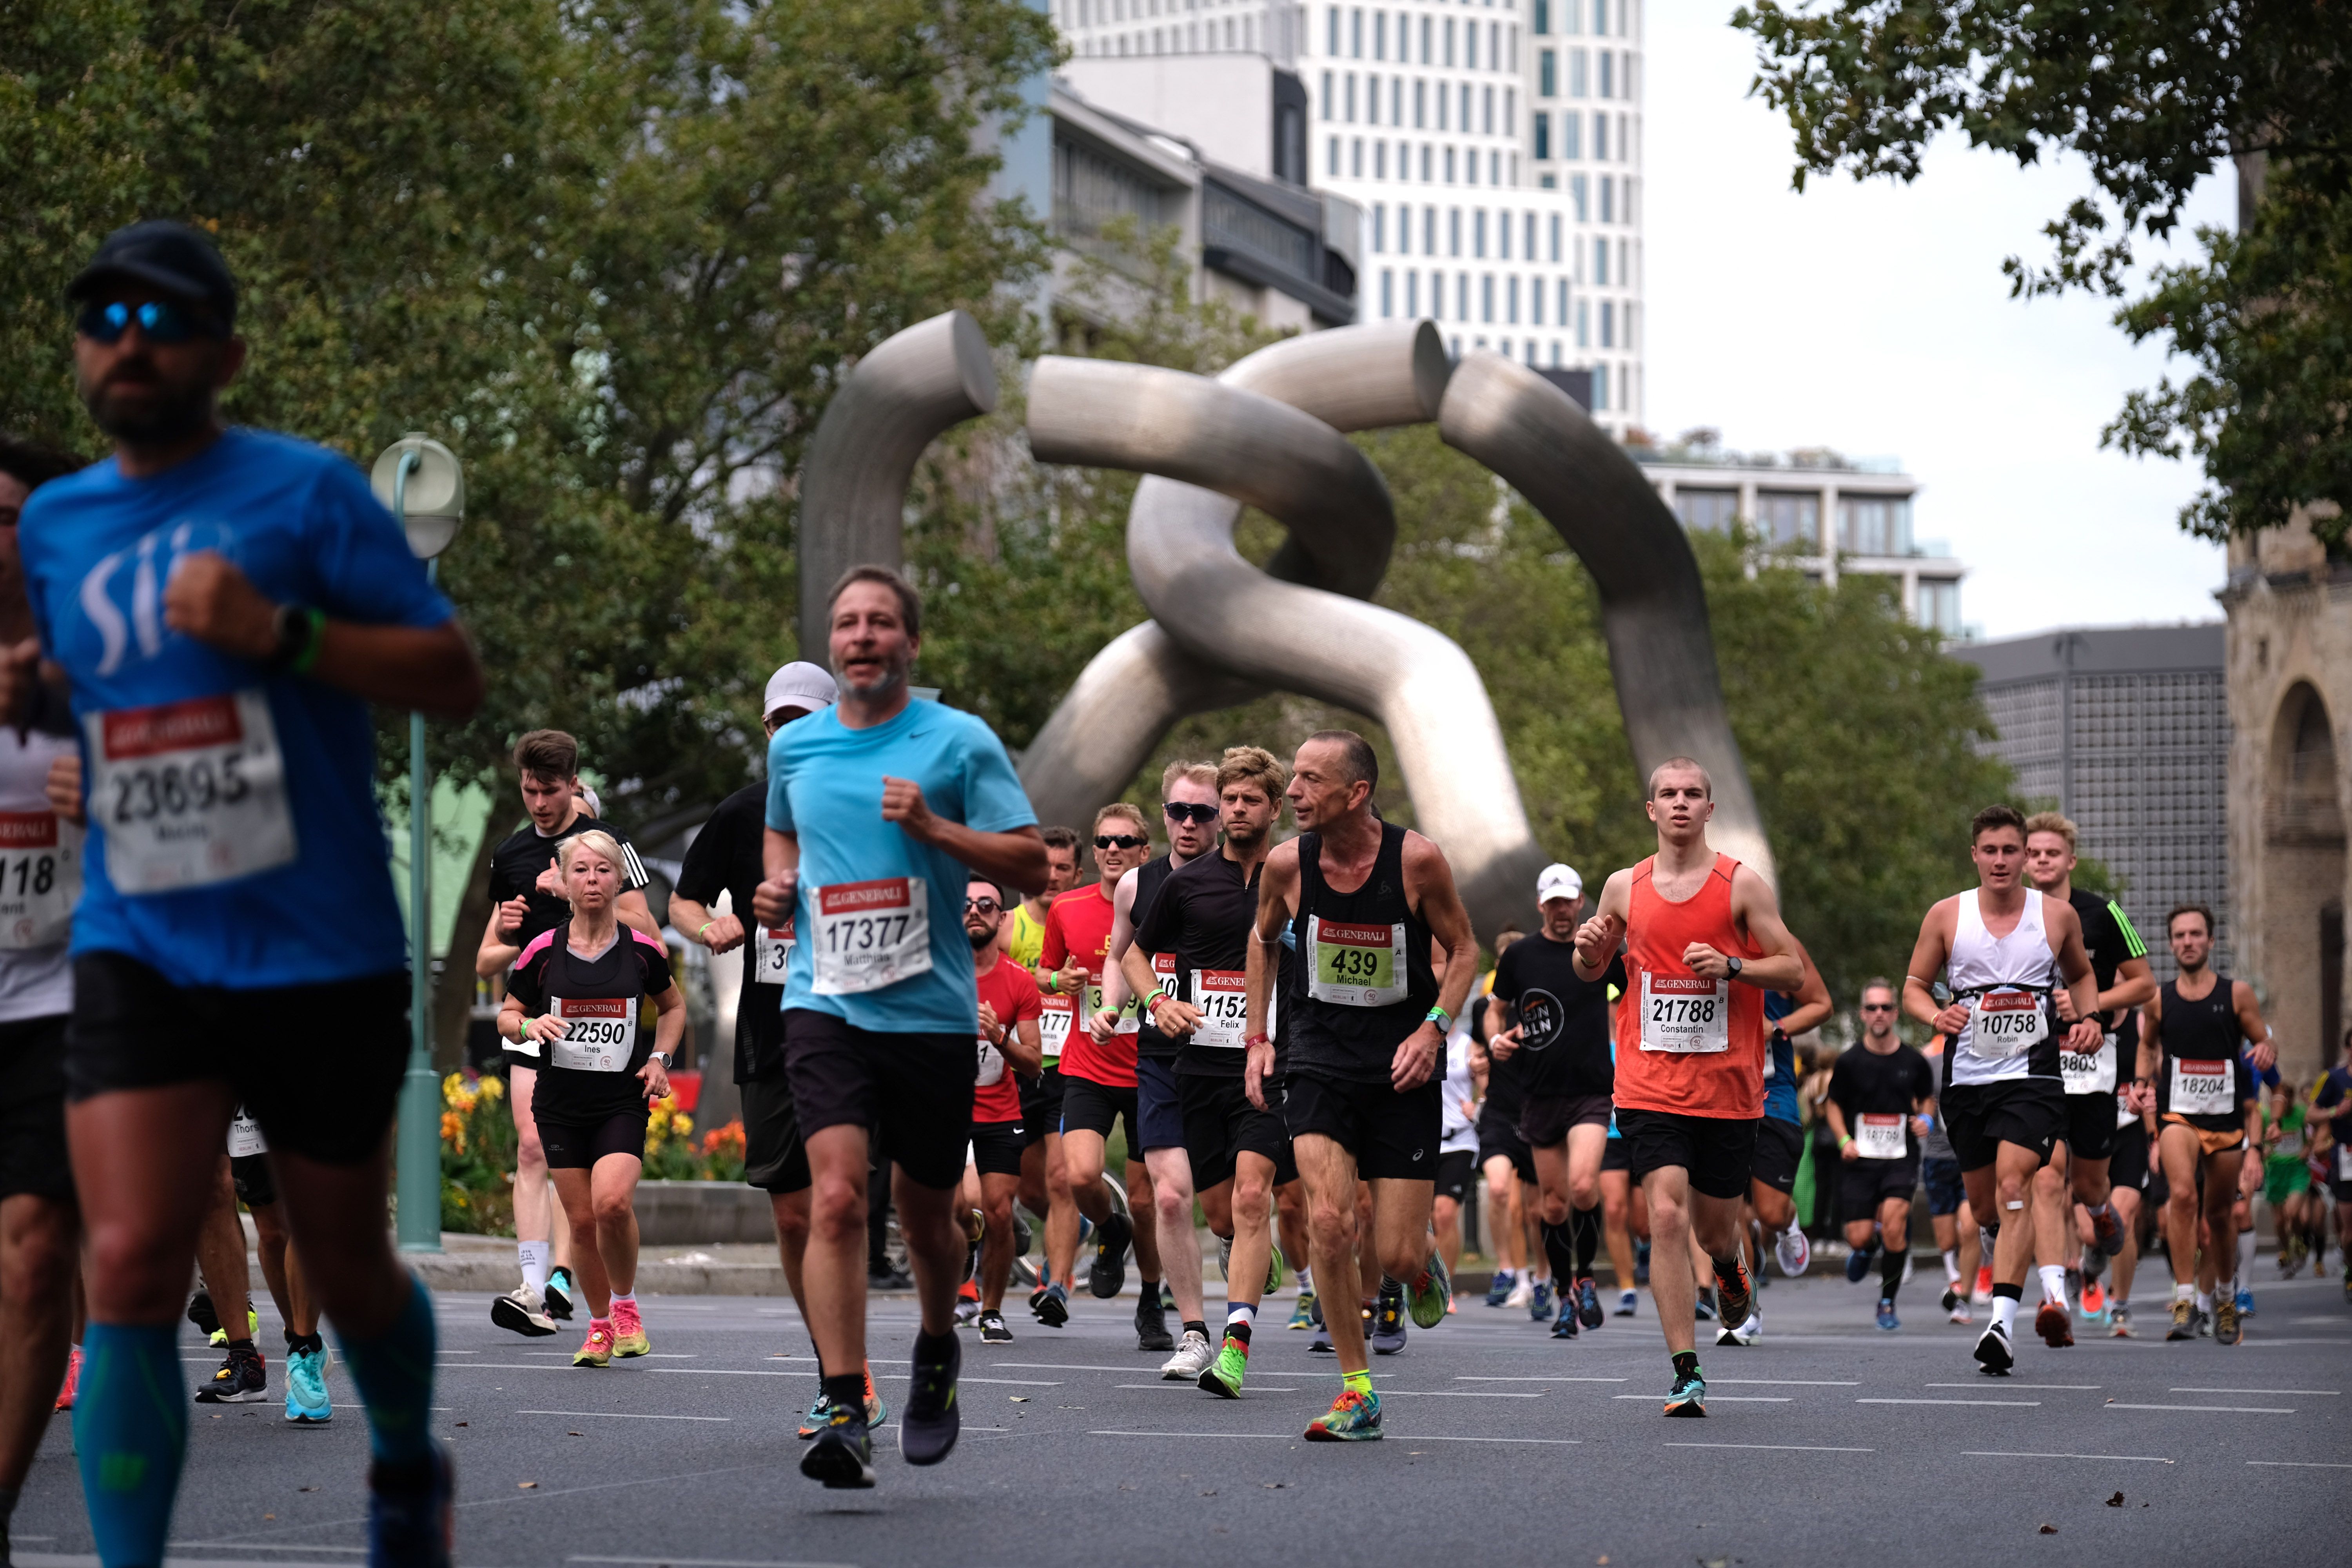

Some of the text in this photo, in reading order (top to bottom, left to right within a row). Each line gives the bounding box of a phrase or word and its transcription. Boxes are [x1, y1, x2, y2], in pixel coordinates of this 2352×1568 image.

[840, 886, 902, 904] GENERALI
[827, 915, 909, 953] 17377
[1337, 929, 1385, 941] GENERALI
[844, 952, 891, 966] Matthias
[1331, 949, 1377, 976] 439
[1337, 975, 1371, 986] Michael
[1667, 980, 1710, 989] GENERALI
[579, 1004, 621, 1013] GENERALI
[1203, 995, 1247, 1018] 1152
[1994, 997, 2031, 1006] GENERALI
[1653, 999, 1715, 1023] 21788
[1221, 1020, 1239, 1029] Felix
[1524, 1018, 1552, 1038] BLN
[1661, 1024, 1703, 1033] Constantin
[1982, 1014, 2036, 1034] 10758
[564, 1022, 625, 1044] 22590
[1997, 1035, 2018, 1043] Robin
[584, 1045, 601, 1053] Ines
[2182, 1078, 2225, 1095] 18204
